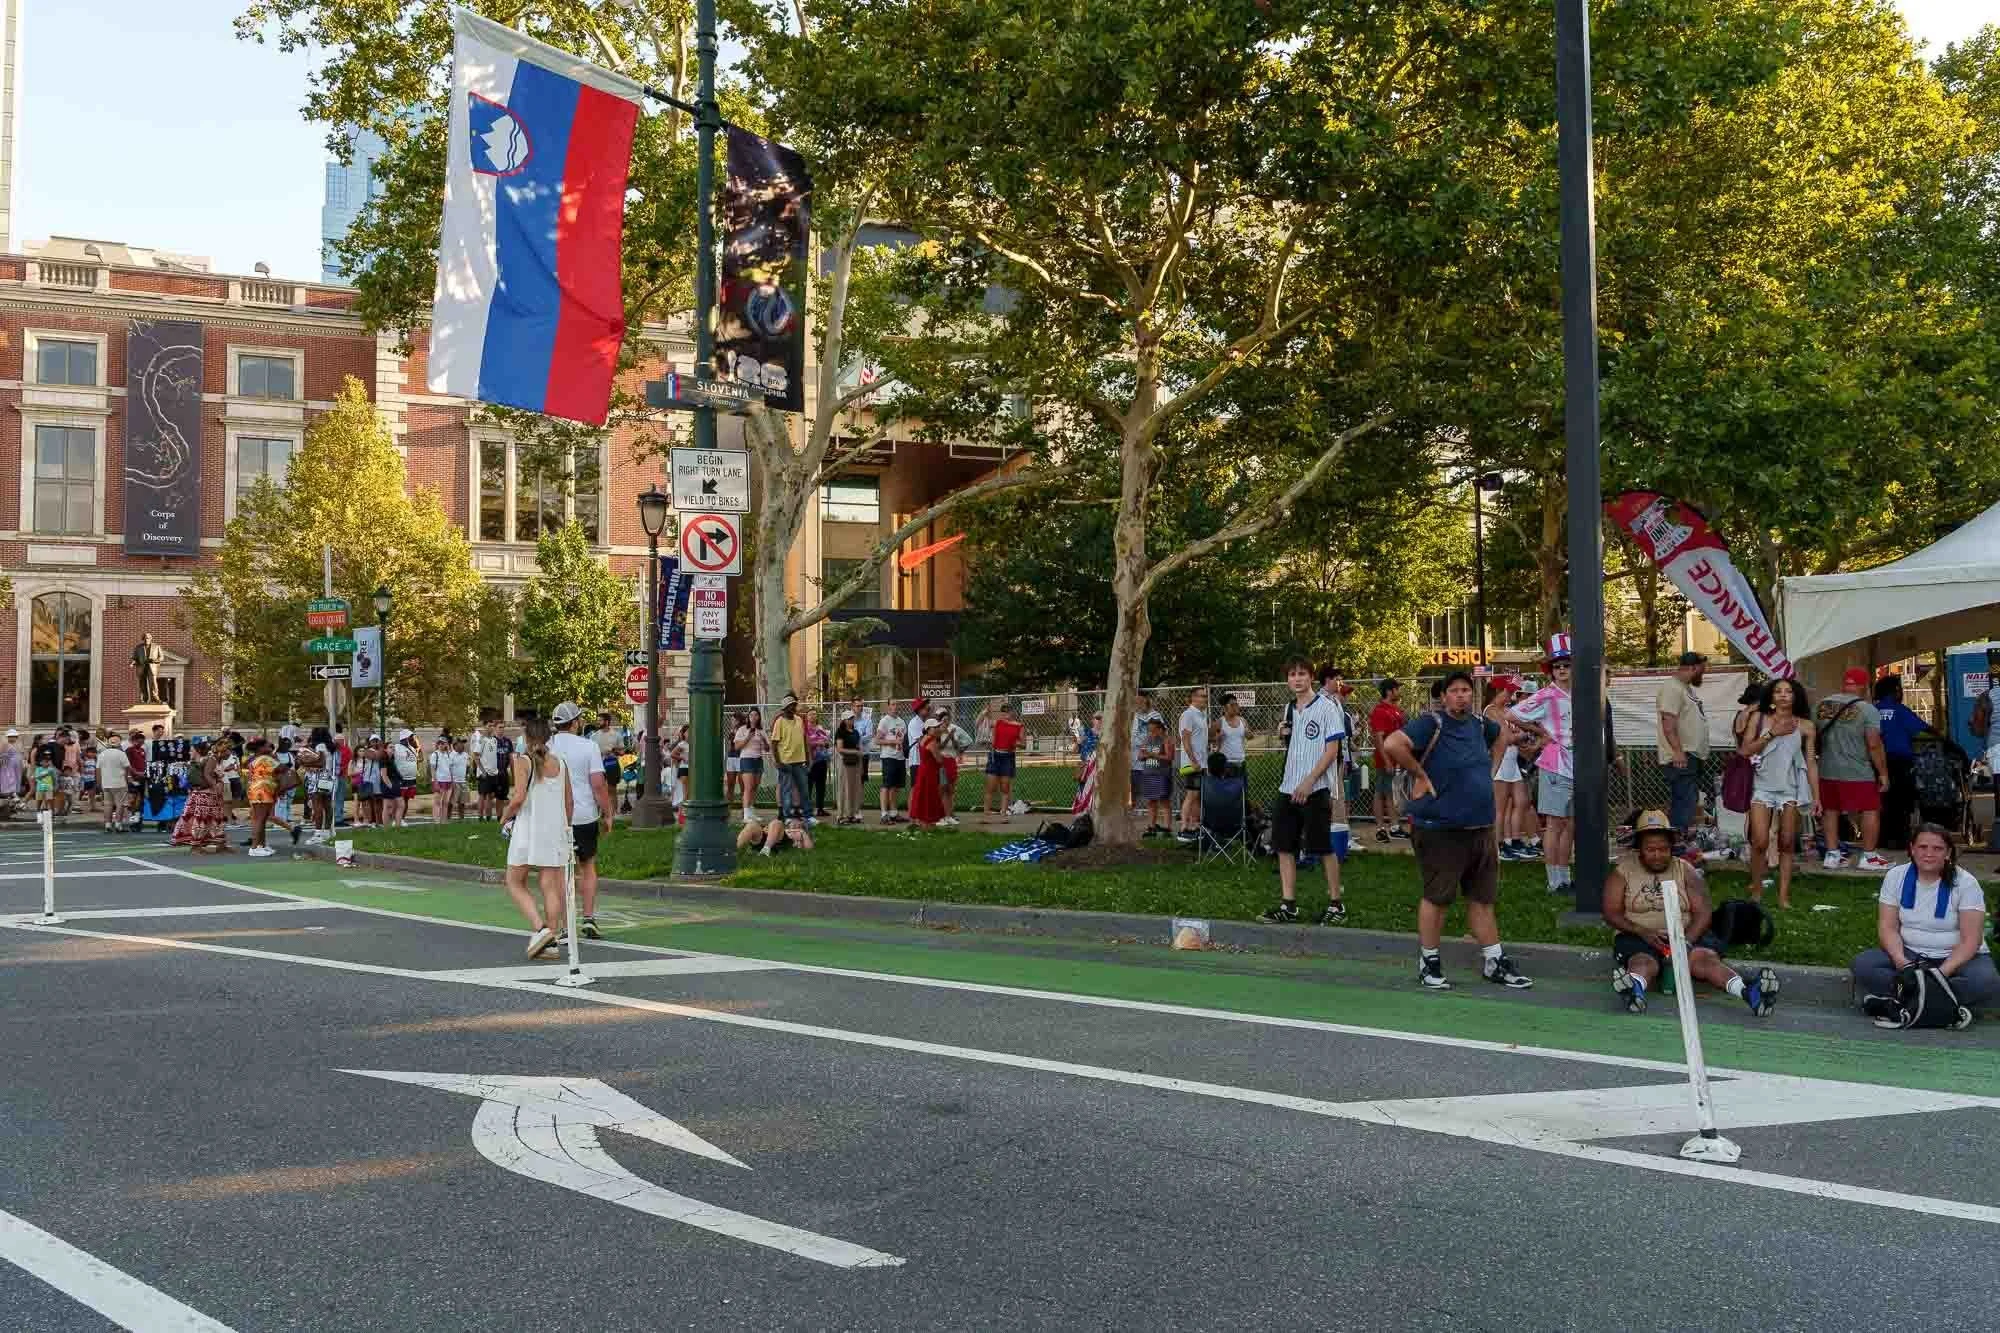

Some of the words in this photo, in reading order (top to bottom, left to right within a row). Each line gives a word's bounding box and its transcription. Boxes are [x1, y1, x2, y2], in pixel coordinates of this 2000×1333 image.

[697, 381, 749, 398] SLOVENIA
[697, 455, 723, 465] BEGIN
[679, 466, 698, 476] RIGHT
[703, 467, 721, 477] TURN
[723, 468, 743, 478] LANE
[684, 496, 704, 505] YIELD
[708, 496, 716, 506] TO
[719, 497, 739, 507] BIKES
[151, 509, 176, 519] Corps
[143, 533, 184, 543] Discovery
[705, 591, 717, 601] NO
[661, 568, 681, 645] PHILADELPHIA
[696, 600, 725, 608] STOPPING
[1688, 559, 1796, 680] NTRANCE
[316, 642, 341, 651] RACE
[1448, 649, 1495, 664] SHOP
